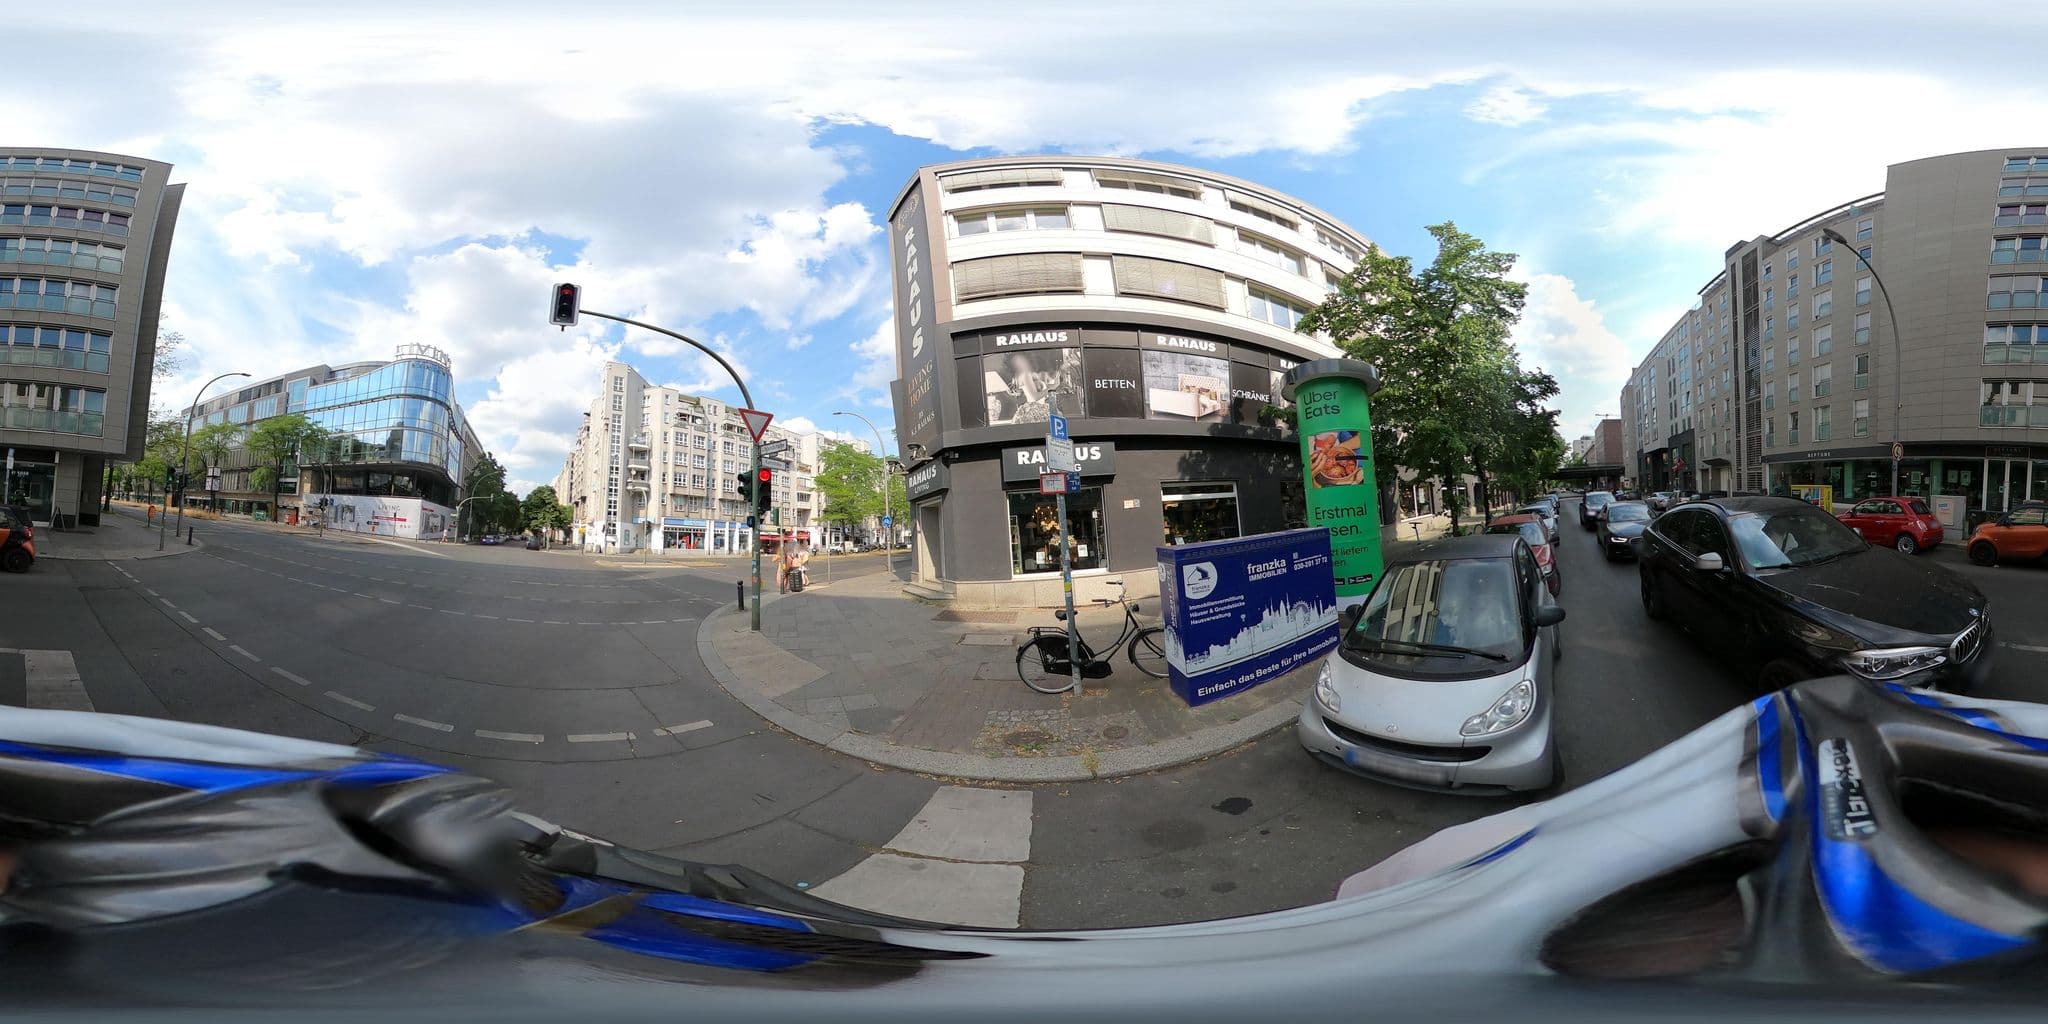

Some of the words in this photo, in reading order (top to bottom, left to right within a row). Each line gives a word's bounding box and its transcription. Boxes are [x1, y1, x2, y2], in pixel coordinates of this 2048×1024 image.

[904, 226, 924, 359] RAHAUS
[995, 331, 1068, 347] RAHAUS
[1156, 335, 1217, 352] RAHAUS
[910, 375, 933, 408] HOME
[1094, 378, 1136, 389] BETTEN
[1231, 388, 1270, 403] SCHRÄNKE
[1303, 389, 1339, 406] Uber
[1305, 403, 1341, 420] Eats
[1054, 418, 1064, 435] P
[1017, 446, 1101, 465] RAUS
[908, 464, 936, 489] RAHAUS
[1314, 504, 1367, 520] Erstmal
[1316, 524, 1362, 537] sen.
[1247, 558, 1287, 575] franzka
[1248, 567, 1287, 582] IMMOBILIEN
[1190, 612, 1232, 626] Hausverwaltung
[1197, 679, 1237, 697] Einfach
[1238, 672, 1255, 684] das
[1256, 663, 1280, 677] Beste
[1281, 656, 1292, 668] für
[1293, 651, 1307, 663] Ihre
[1307, 635, 1338, 656] Immobilie
